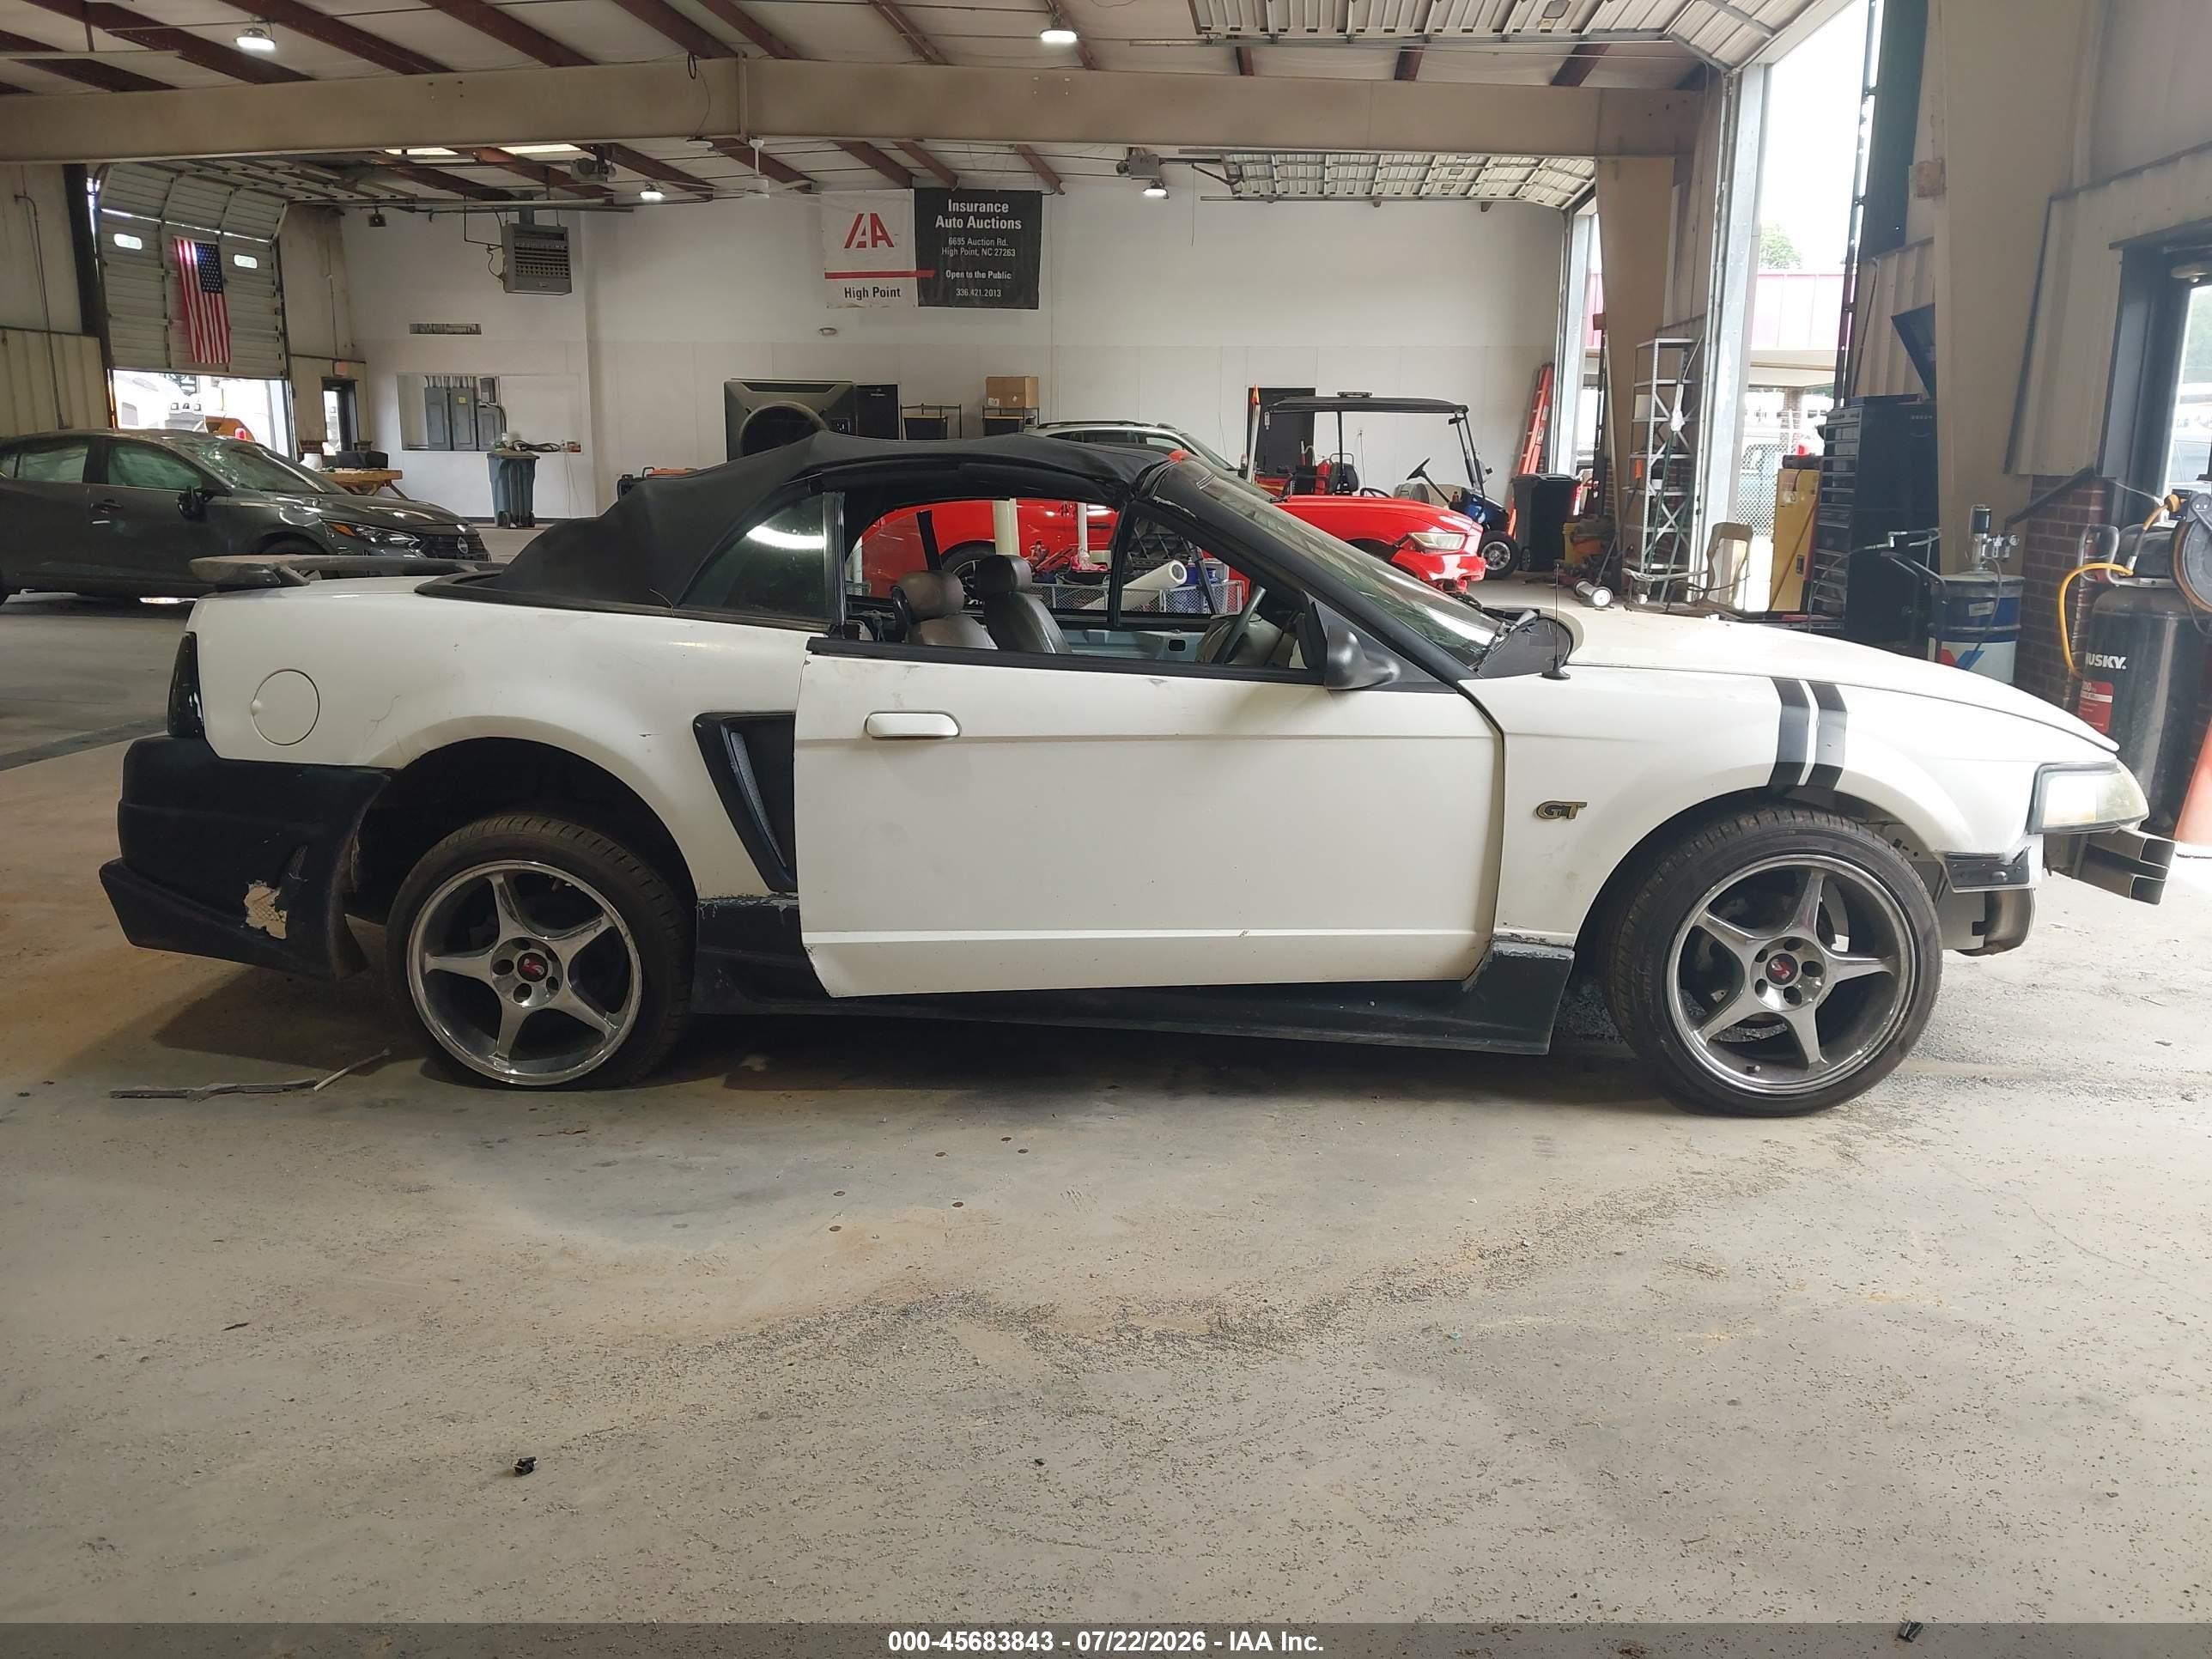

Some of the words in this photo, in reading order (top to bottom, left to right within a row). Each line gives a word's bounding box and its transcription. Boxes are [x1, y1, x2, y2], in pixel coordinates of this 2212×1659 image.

[948, 199, 1009, 212] Insurance
[935, 215, 963, 228] Auto
[966, 216, 1022, 229] Auctions
[968, 237, 994, 246] Auction
[942, 247, 958, 257] High
[960, 247, 979, 256] Point,
[981, 248, 992, 257] NC
[994, 248, 1016, 257] 27263
[945, 270, 964, 279] Open
[844, 287, 869, 301] High
[872, 287, 901, 298] Point
[956, 288, 1002, 297] 336.421.2013
[1536, 800, 1587, 819] GT
